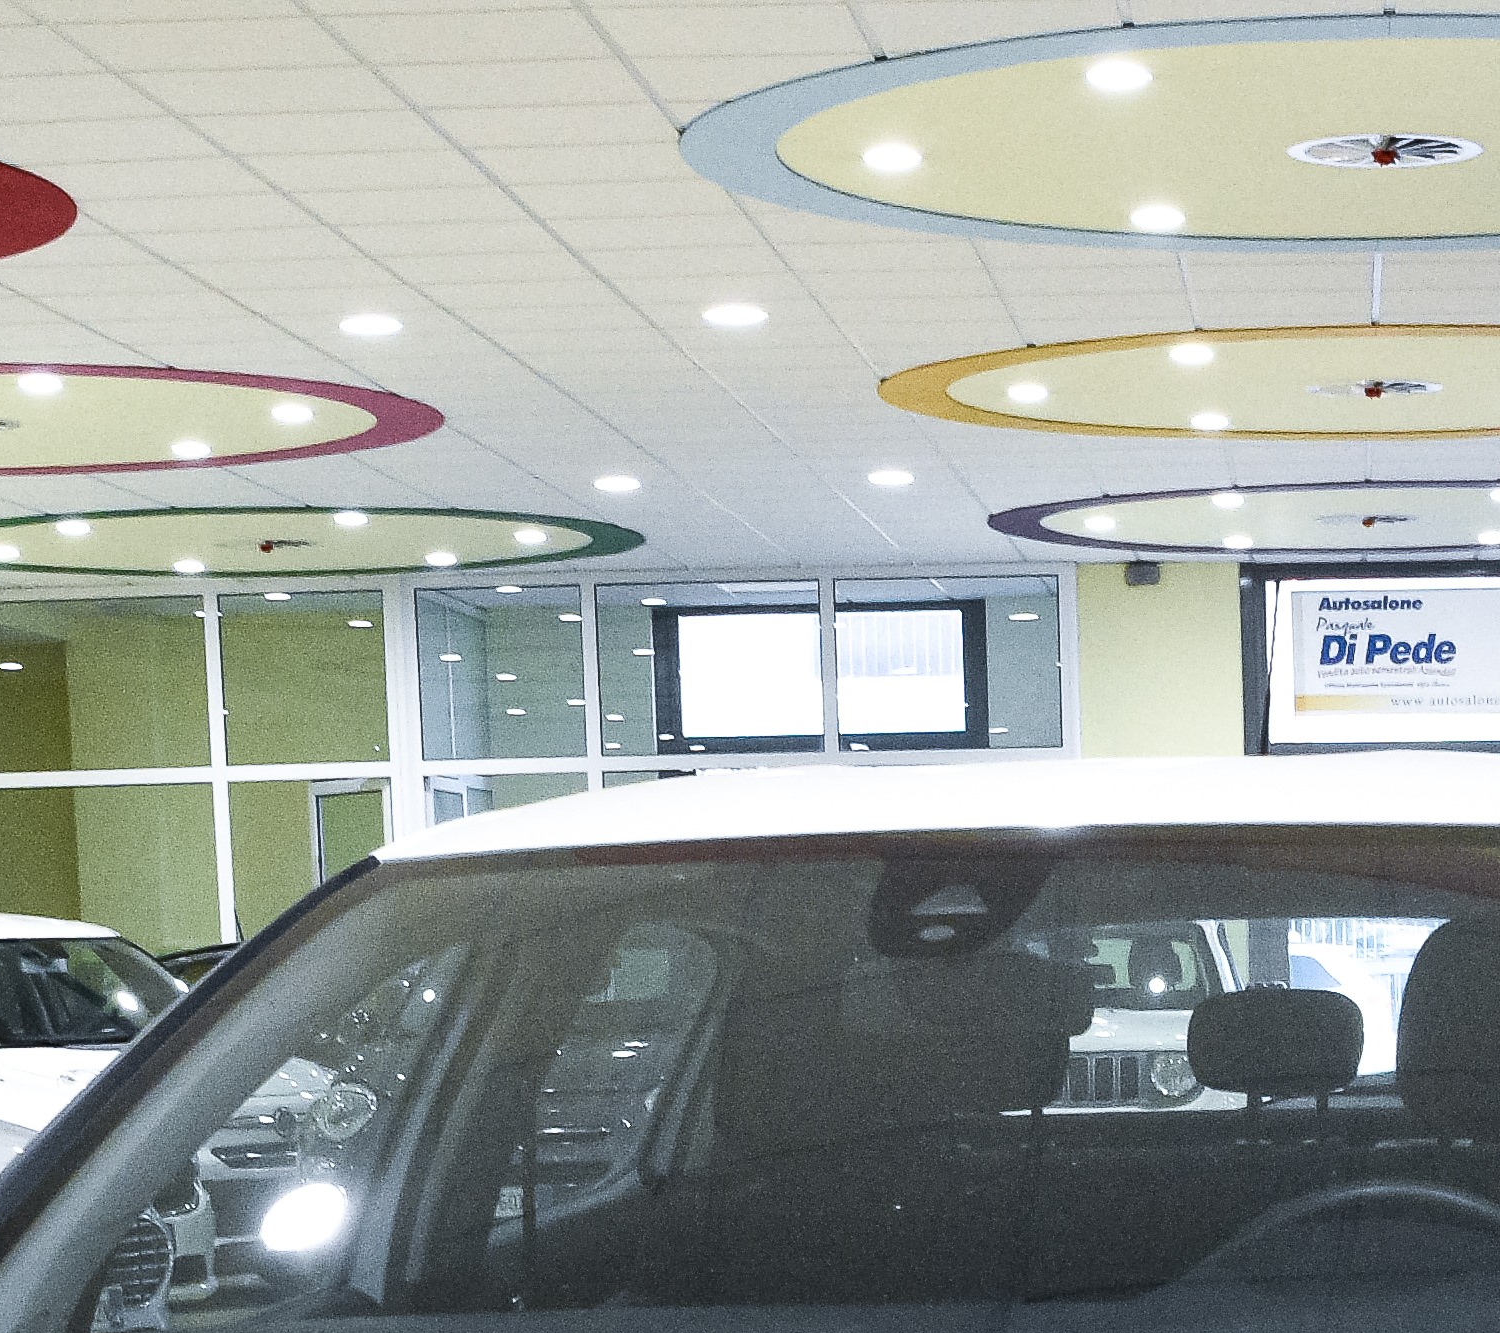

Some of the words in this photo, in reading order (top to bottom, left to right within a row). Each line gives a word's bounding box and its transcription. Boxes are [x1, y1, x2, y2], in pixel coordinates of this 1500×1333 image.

[1318, 596, 1423, 611] Autosalone
[1320, 634, 1357, 665] Di
[1365, 633, 1457, 665] Pede
